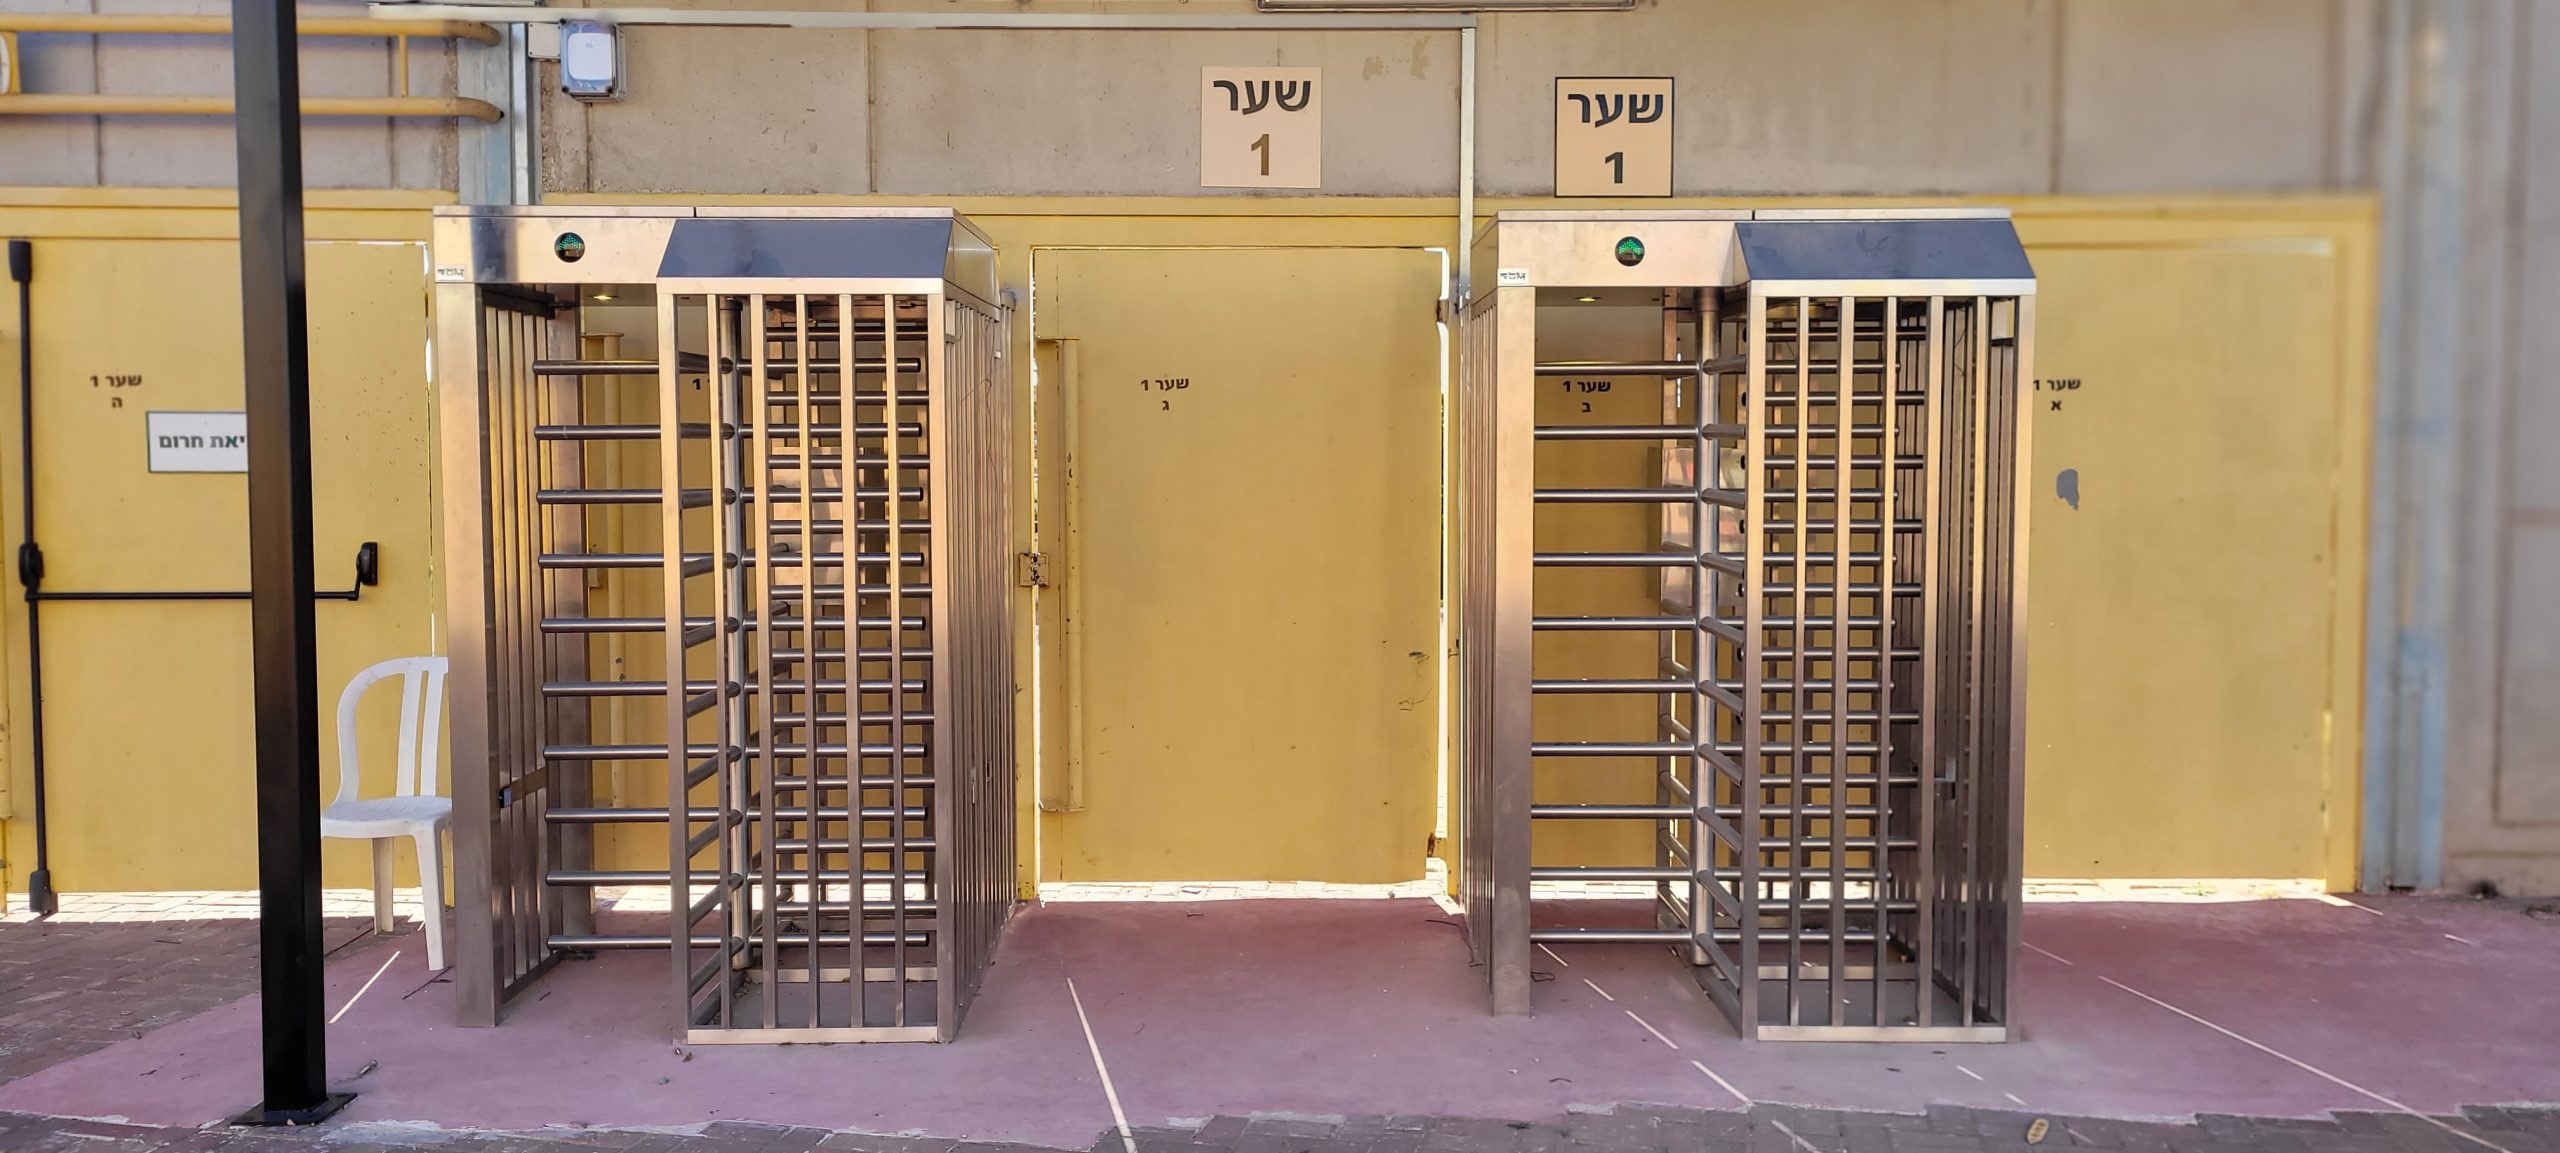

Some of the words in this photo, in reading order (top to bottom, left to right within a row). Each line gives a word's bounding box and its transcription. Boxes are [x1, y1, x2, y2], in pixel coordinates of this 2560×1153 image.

[1213, 80, 1311, 115] שער
[1567, 93, 1664, 128] שער
[1250, 133, 1270, 176] 1
[1604, 151, 1624, 184] 1
[90, 375, 99, 387] 1
[105, 375, 142, 388] שער
[1140, 379, 1149, 391] 1
[1155, 378, 1190, 391] שער
[1562, 380, 1571, 392] 1
[1577, 381, 1611, 393] שער
[2032, 379, 2041, 391] 1
[2046, 379, 2081, 391] שער
[111, 397, 124, 408] ה
[1161, 400, 1170, 411] ג
[1581, 402, 1592, 413] ב
[2050, 400, 2062, 412] א
[158, 435, 204, 449] חרום
